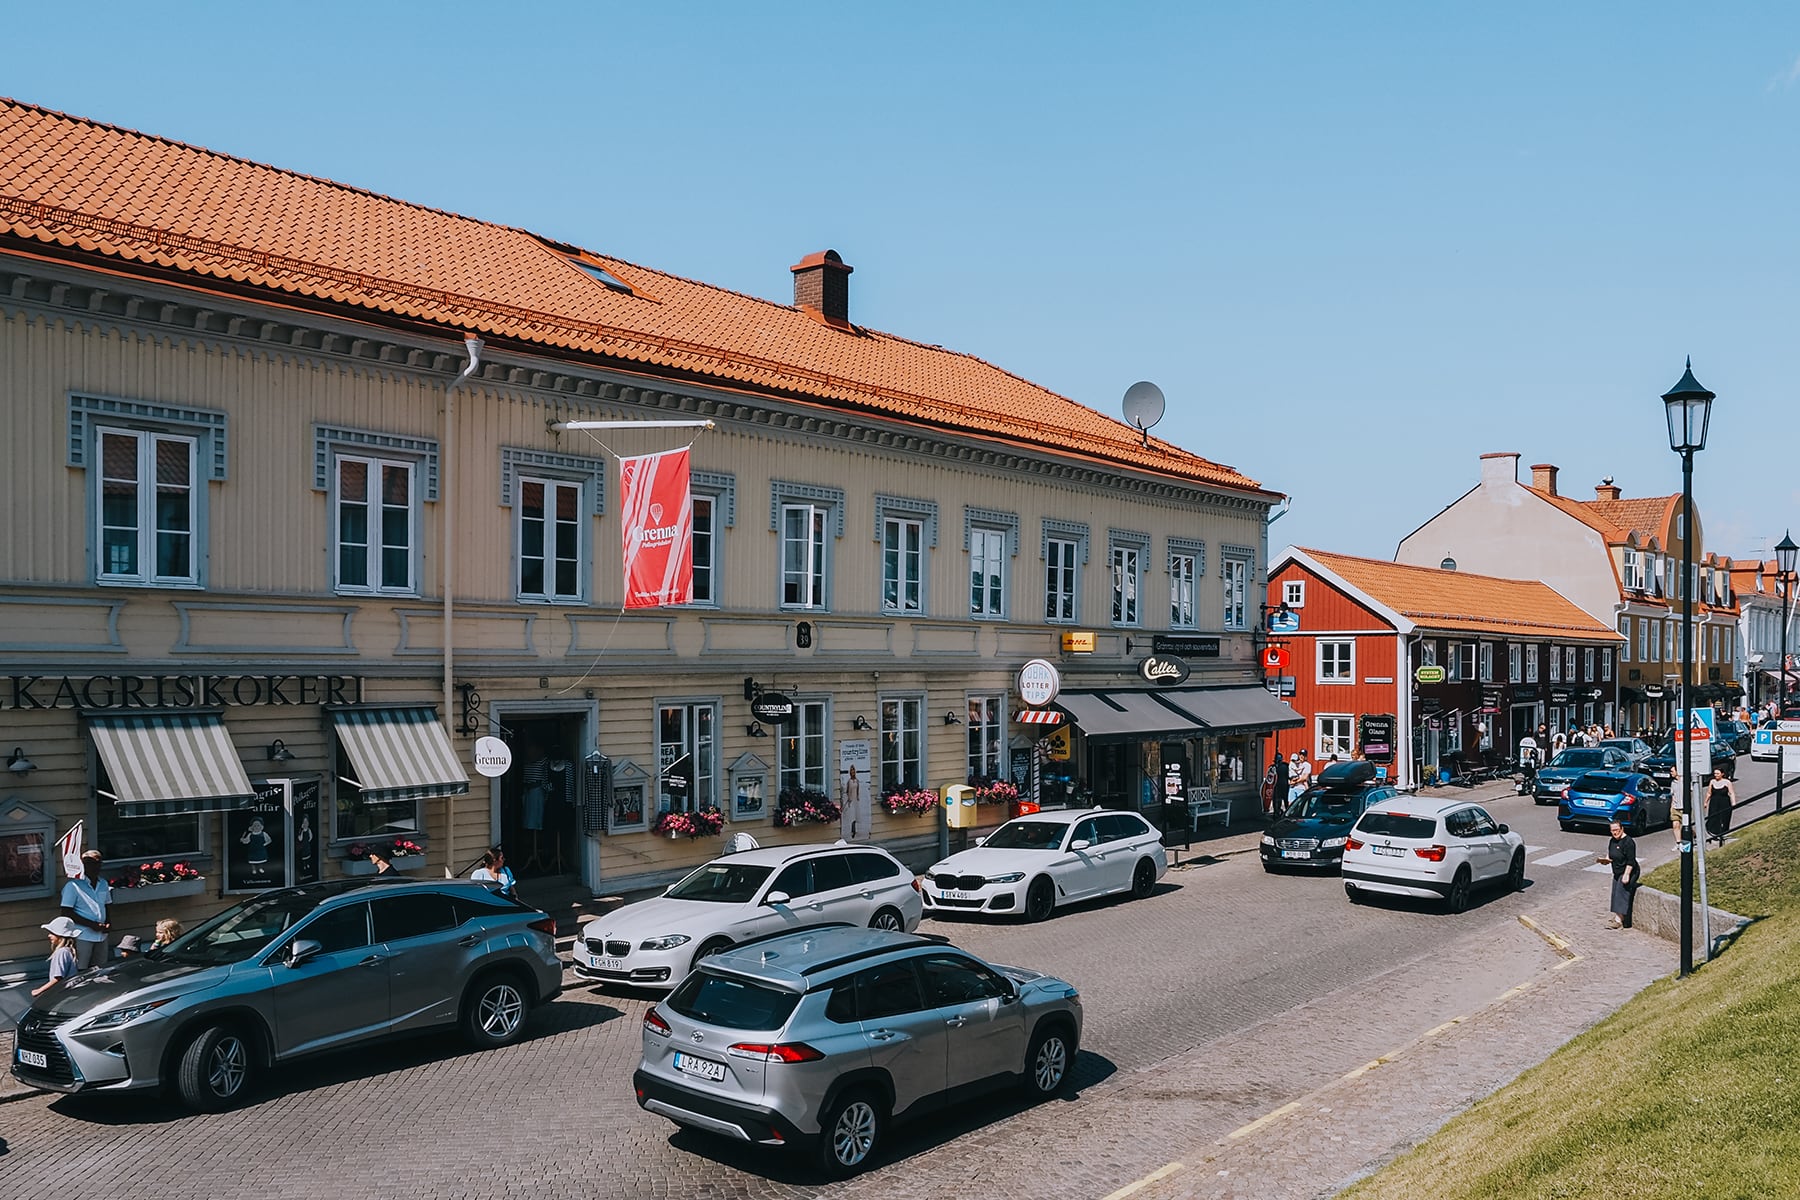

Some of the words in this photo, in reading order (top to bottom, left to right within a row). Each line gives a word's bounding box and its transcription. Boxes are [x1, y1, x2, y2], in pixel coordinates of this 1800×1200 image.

[633, 525, 679, 542] Grenna
[800, 635, 808, 645] 39
[1144, 658, 1181, 680] Calles
[0, 675, 365, 710] KAGRISKOKERI
[1026, 691, 1046, 699] TIPS
[754, 703, 791, 712] COUNTRYLIN
[607, 959, 619, 967] 819
[32, 1053, 45, 1065] 035
[682, 1056, 699, 1072] LRA
[701, 1062, 720, 1077] 92A
